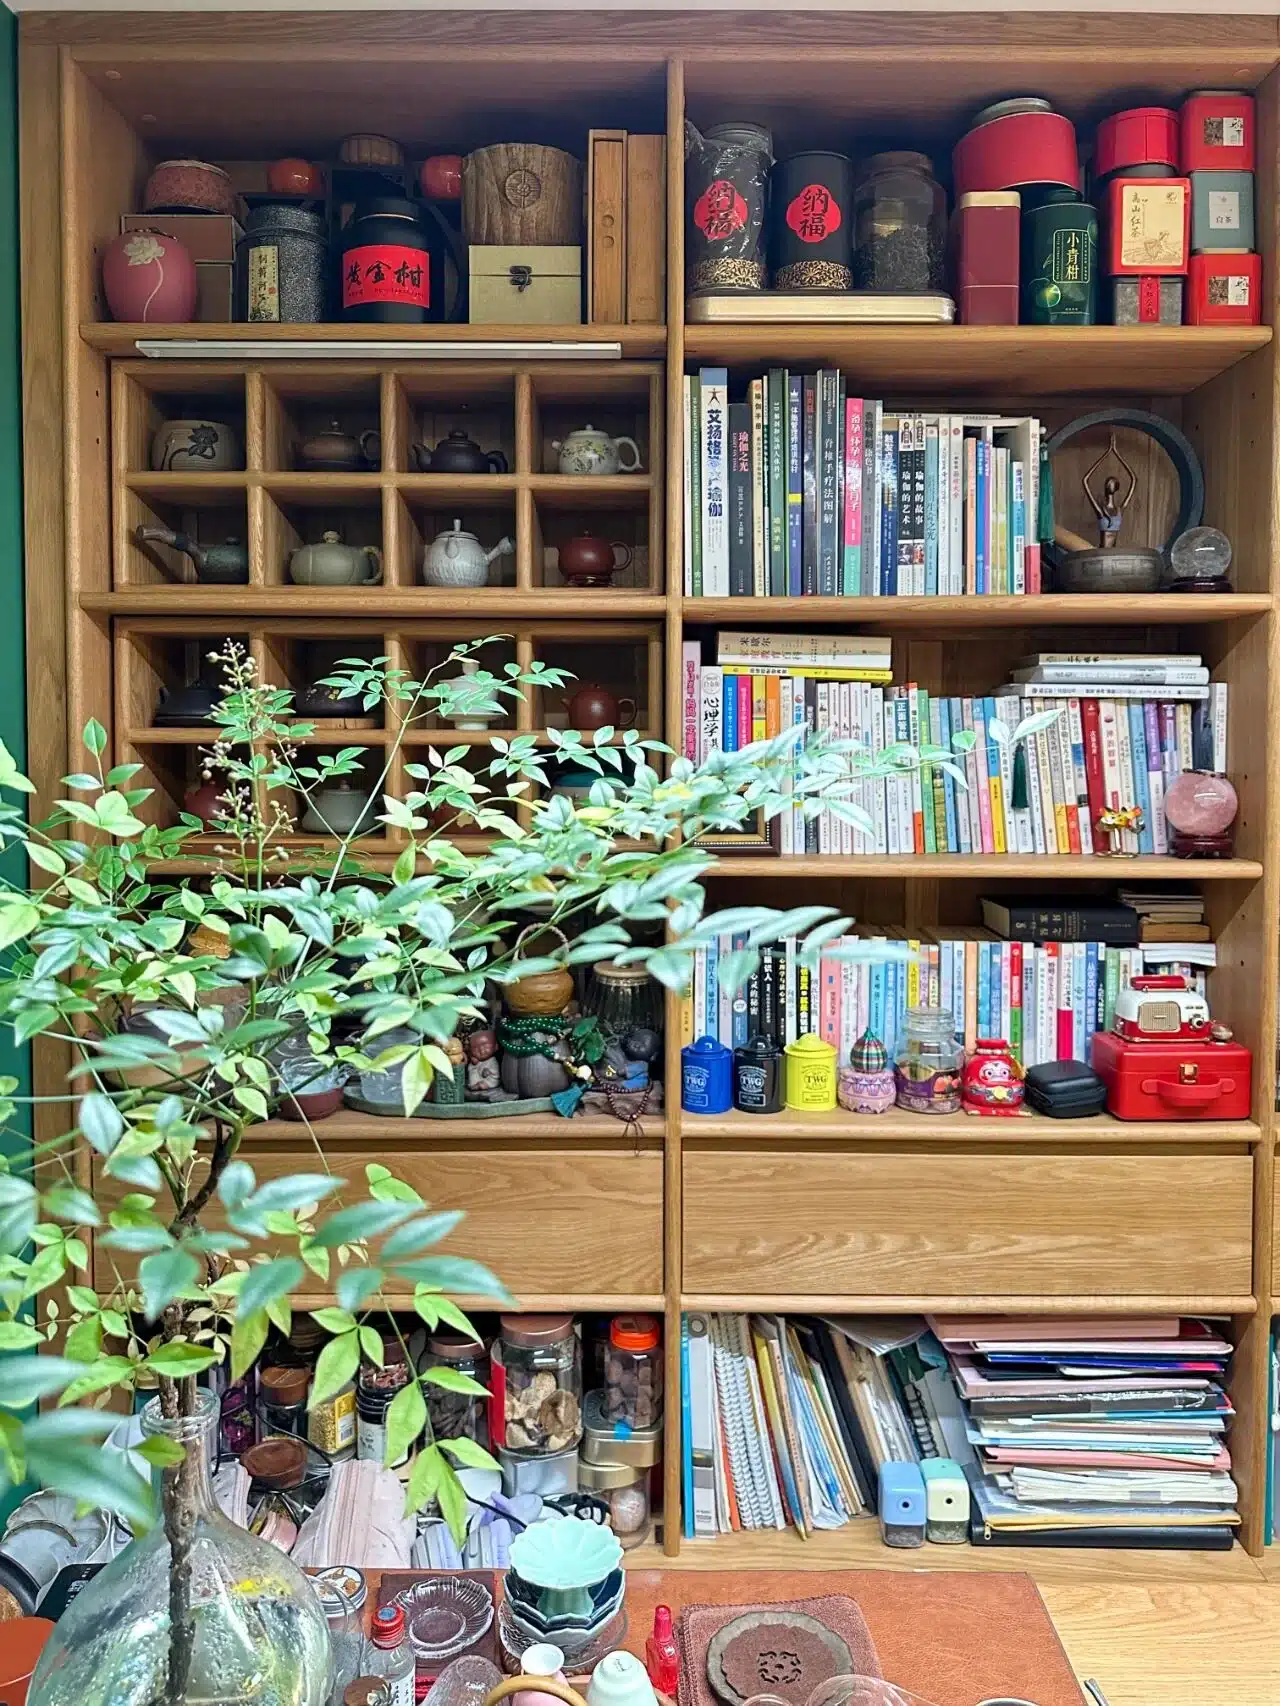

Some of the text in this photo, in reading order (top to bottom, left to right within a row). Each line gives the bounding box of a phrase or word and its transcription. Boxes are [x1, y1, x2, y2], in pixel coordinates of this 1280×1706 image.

[705, 182, 735, 235] 纳福
[799, 188, 829, 237] 纳福
[1131, 192, 1141, 238] 高山红茶
[1066, 232, 1080, 280] 小青柑
[739, 432, 749, 472] 瑜伽之光
[902, 471, 911, 524] 瑜伽的艺术
[914, 471, 924, 524] 瑜伽的故事
[704, 697, 719, 737] 心理学
[897, 703, 907, 741] 正面管教
[686, 1076, 704, 1086] TWG
[741, 1076, 761, 1086] TWG
[807, 1076, 827, 1084] TWG
